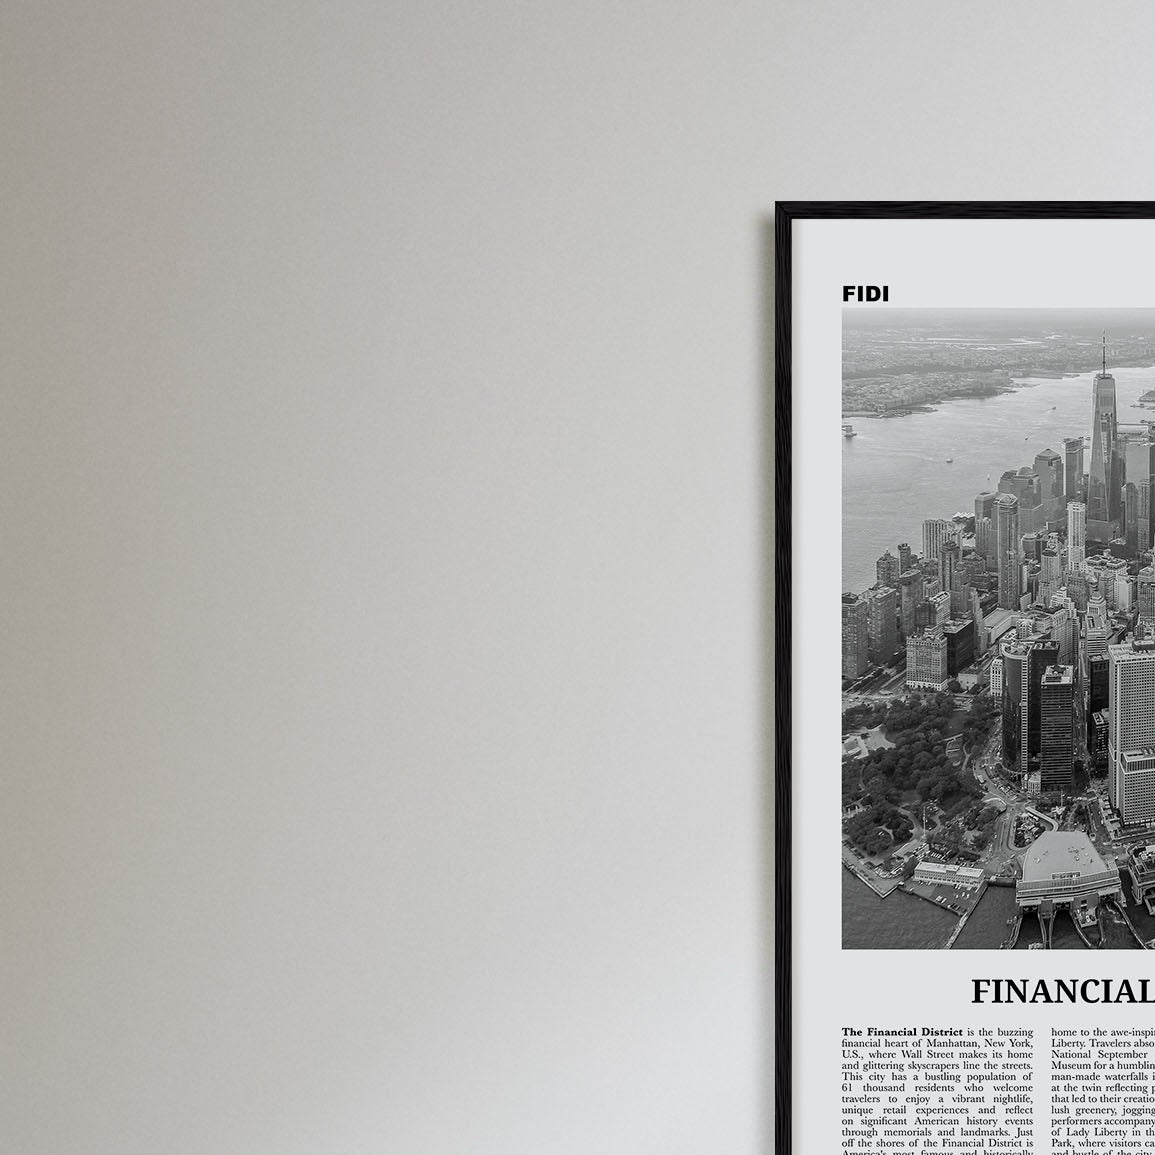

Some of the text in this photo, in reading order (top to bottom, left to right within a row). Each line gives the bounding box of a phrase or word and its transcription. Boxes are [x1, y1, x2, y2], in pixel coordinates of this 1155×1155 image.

[843, 285, 889, 302] FIDI
[841, 1028, 1034, 1039] The Financial District is the buzzing
[841, 1039, 1033, 1049] financial heart of Manhattan, New York,
[1051, 1039, 1086, 1050] Liberty.
[1089, 1039, 1132, 1047] Travelers
[1051, 1050, 1091, 1058] National
[1098, 1050, 1148, 1061] September
[841, 1061, 859, 1069] and
[862, 1061, 905, 1072] glittering
[907, 1061, 960, 1072] skyscrapers
[963, 1061, 980, 1069] line
[983, 1061, 998, 1069] the
[1051, 1072, 1101, 1081] man-made
[1104, 1072, 1149, 1081] waterfalls
[841, 1083, 1033, 1092] 61 thousand residents who welcome
[842, 1105, 1033, 1116] unique retail experiences and reflect
[1051, 1105, 1070, 1114] lush
[1075, 1108, 1117, 1116] greenery,
[860, 1117, 907, 1127] significant
[914, 1117, 959, 1125] American
[966, 1117, 998, 1127] history
[1051, 1117, 1102, 1127] performers
[842, 1128, 1033, 1138] through memorials and landmarks. Just
[1051, 1128, 1061, 1136] of
[1067, 1128, 1090, 1138] Lady
[1094, 1128, 1128, 1138] Liberty
[1132, 1128, 1141, 1136] in
[1052, 1139, 1075, 1148] Park,
[1078, 1139, 1106, 1147] where
[1109, 1139, 1142, 1147] visitors
